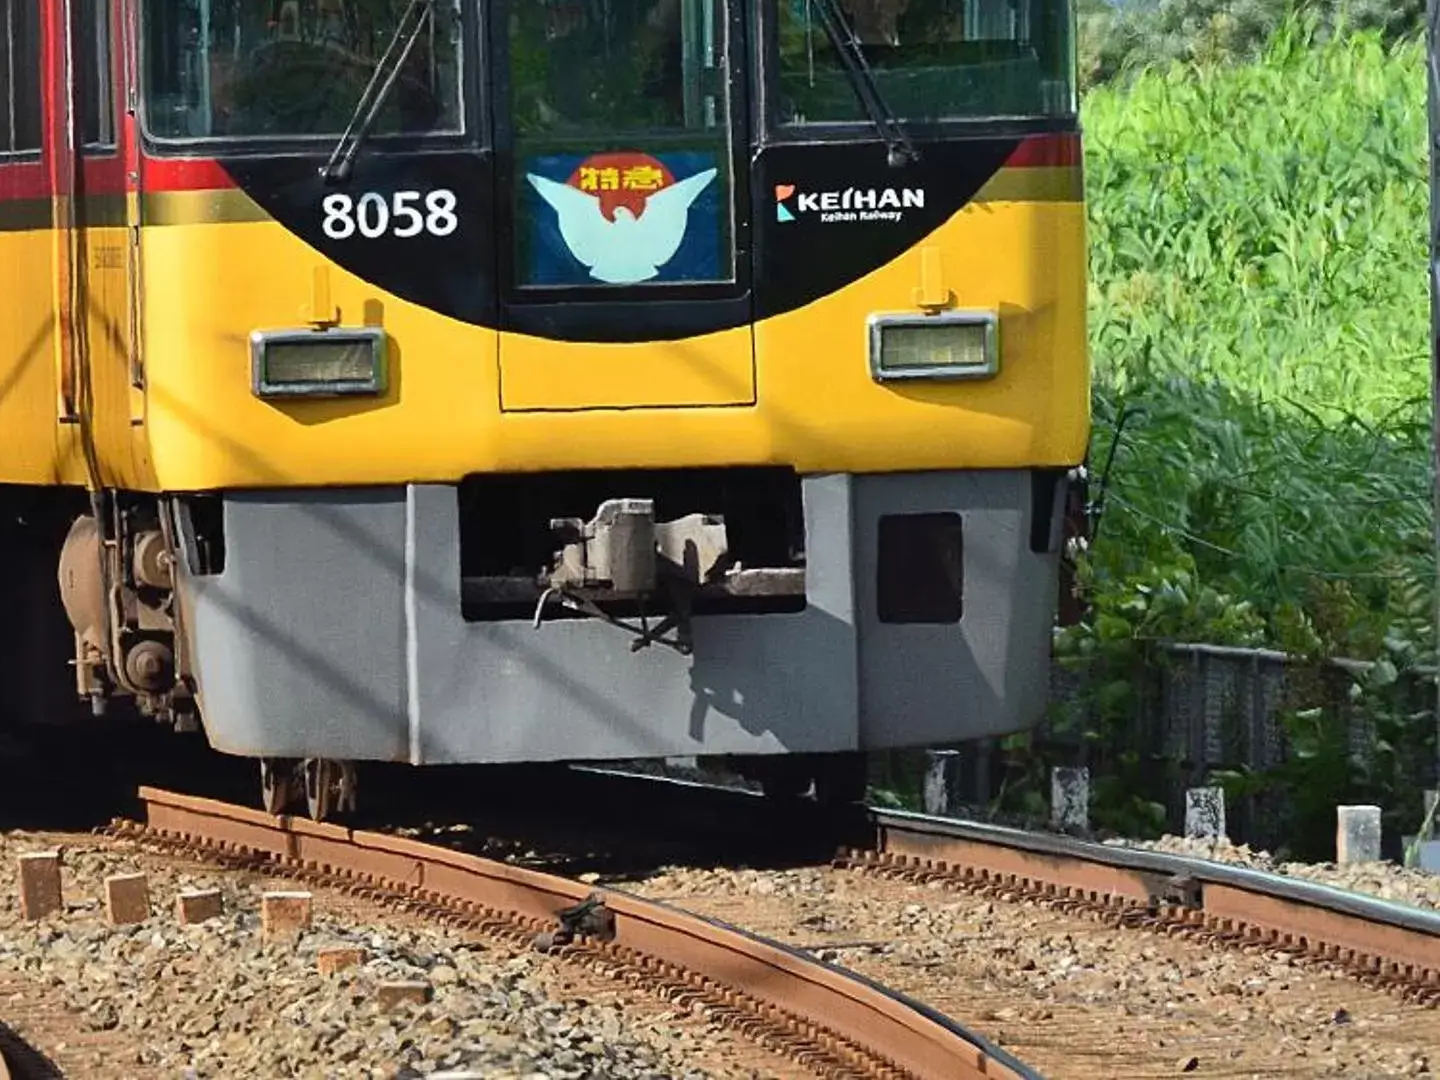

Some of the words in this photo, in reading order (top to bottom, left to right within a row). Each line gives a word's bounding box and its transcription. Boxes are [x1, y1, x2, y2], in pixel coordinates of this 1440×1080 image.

[580, 166, 664, 190] 特急
[798, 187, 924, 211] KEIHAN
[322, 189, 458, 239] 8058
[821, 212, 857, 222] Keihan
[860, 211, 902, 222] Railway
